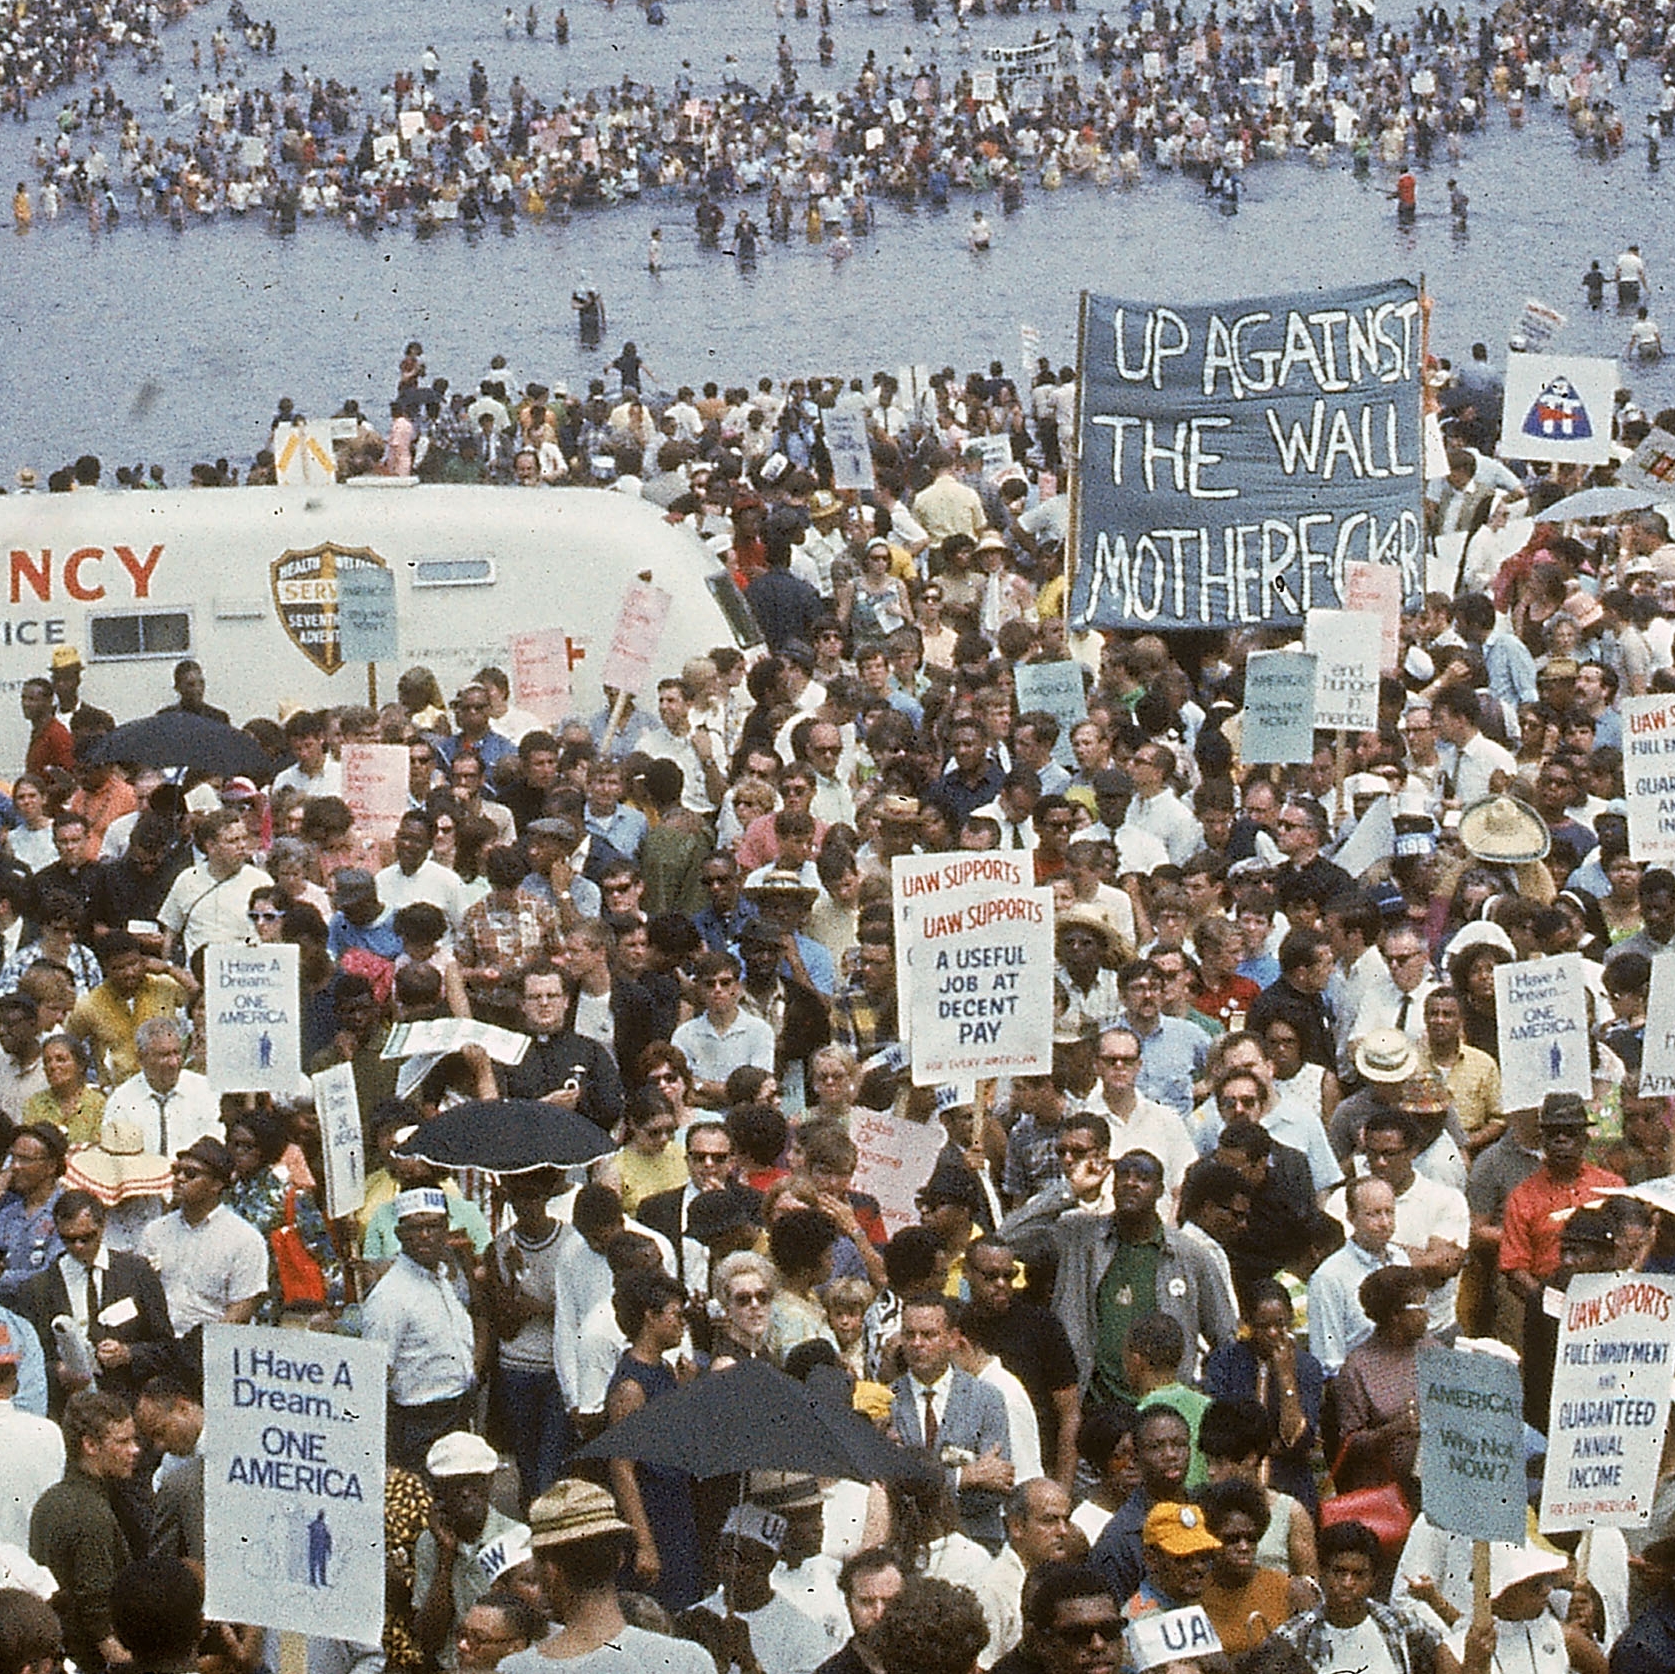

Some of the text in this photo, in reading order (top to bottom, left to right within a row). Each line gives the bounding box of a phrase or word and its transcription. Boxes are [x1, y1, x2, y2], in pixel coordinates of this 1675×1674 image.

[1115, 300, 1420, 400] UP AGAINST
[1092, 398, 1414, 500] THE WALL
[1333, 662, 1363, 677] end
[1629, 711, 1666, 735] UAW
[1631, 737, 1661, 755] FULL
[903, 860, 1022, 897] UAW SUPPORTS
[923, 912, 963, 939] UAW
[967, 898, 1043, 929] SUPPORTS
[227, 960, 266, 973] Have
[270, 958, 281, 971] A
[937, 945, 1027, 970] A USEFUL
[938, 974, 1019, 994] JOB AT
[1516, 971, 1551, 988] Have
[1556, 967, 1567, 980] A
[234, 994, 266, 1007] ONE
[938, 996, 1019, 1020] DECENT
[218, 1009, 288, 1025] AMERICA
[1523, 1005, 1554, 1023] ONE
[958, 1020, 1002, 1045] PAY
[1510, 1018, 1576, 1041] AMERICA
[1568, 1282, 1673, 1332] UAW SUPPORTS
[1564, 1341, 1670, 1365] FULL EMPLOYMENT
[249, 1348, 324, 1384] Have
[333, 1360, 354, 1391] A
[1558, 1399, 1657, 1431] GUARANTEED
[261, 1426, 328, 1463] ONE
[1572, 1435, 1625, 1459] ANNUAL
[228, 1457, 364, 1503] AMERICA
[1449, 1454, 1509, 1483] NOW?
[1568, 1464, 1623, 1489] INCOME
